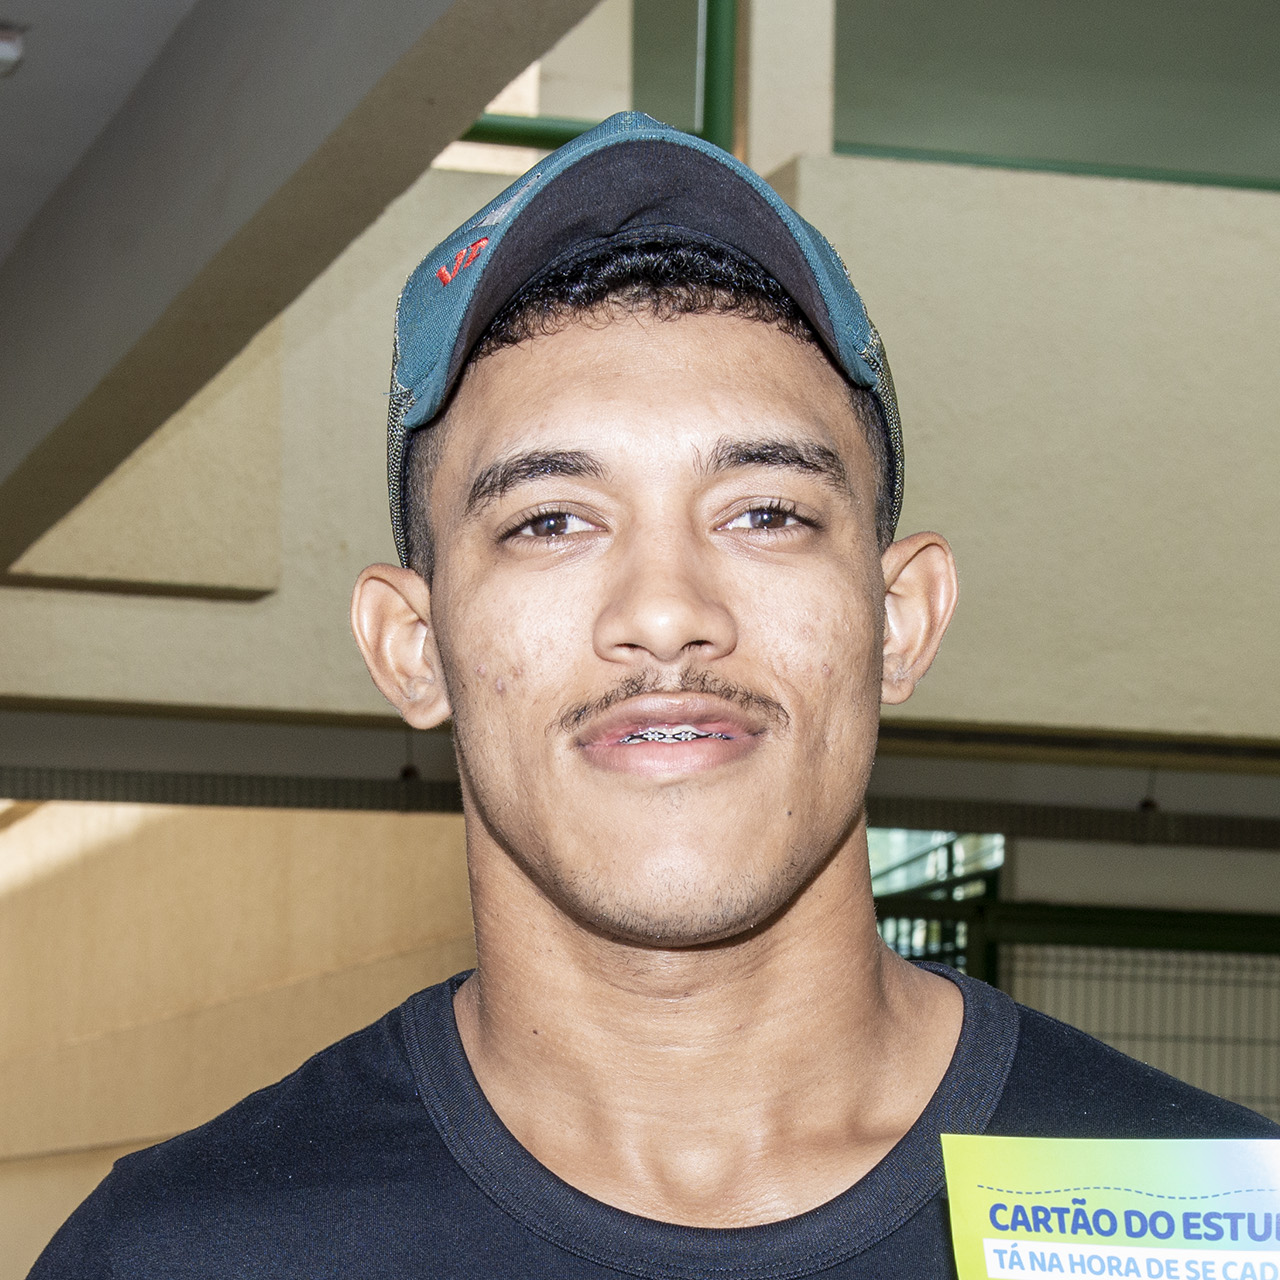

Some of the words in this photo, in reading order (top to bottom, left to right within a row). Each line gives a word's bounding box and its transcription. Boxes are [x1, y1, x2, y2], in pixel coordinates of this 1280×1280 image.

[989, 1198, 1117, 1238] CARTÃO
[1125, 1210, 1175, 1240] DO
[993, 1244, 1025, 1271] TÁ
[1030, 1254, 1063, 1273] NA
[1070, 1255, 1139, 1277] HORA
[1146, 1259, 1181, 1280] DE
[1186, 1260, 1217, 1280] SE
